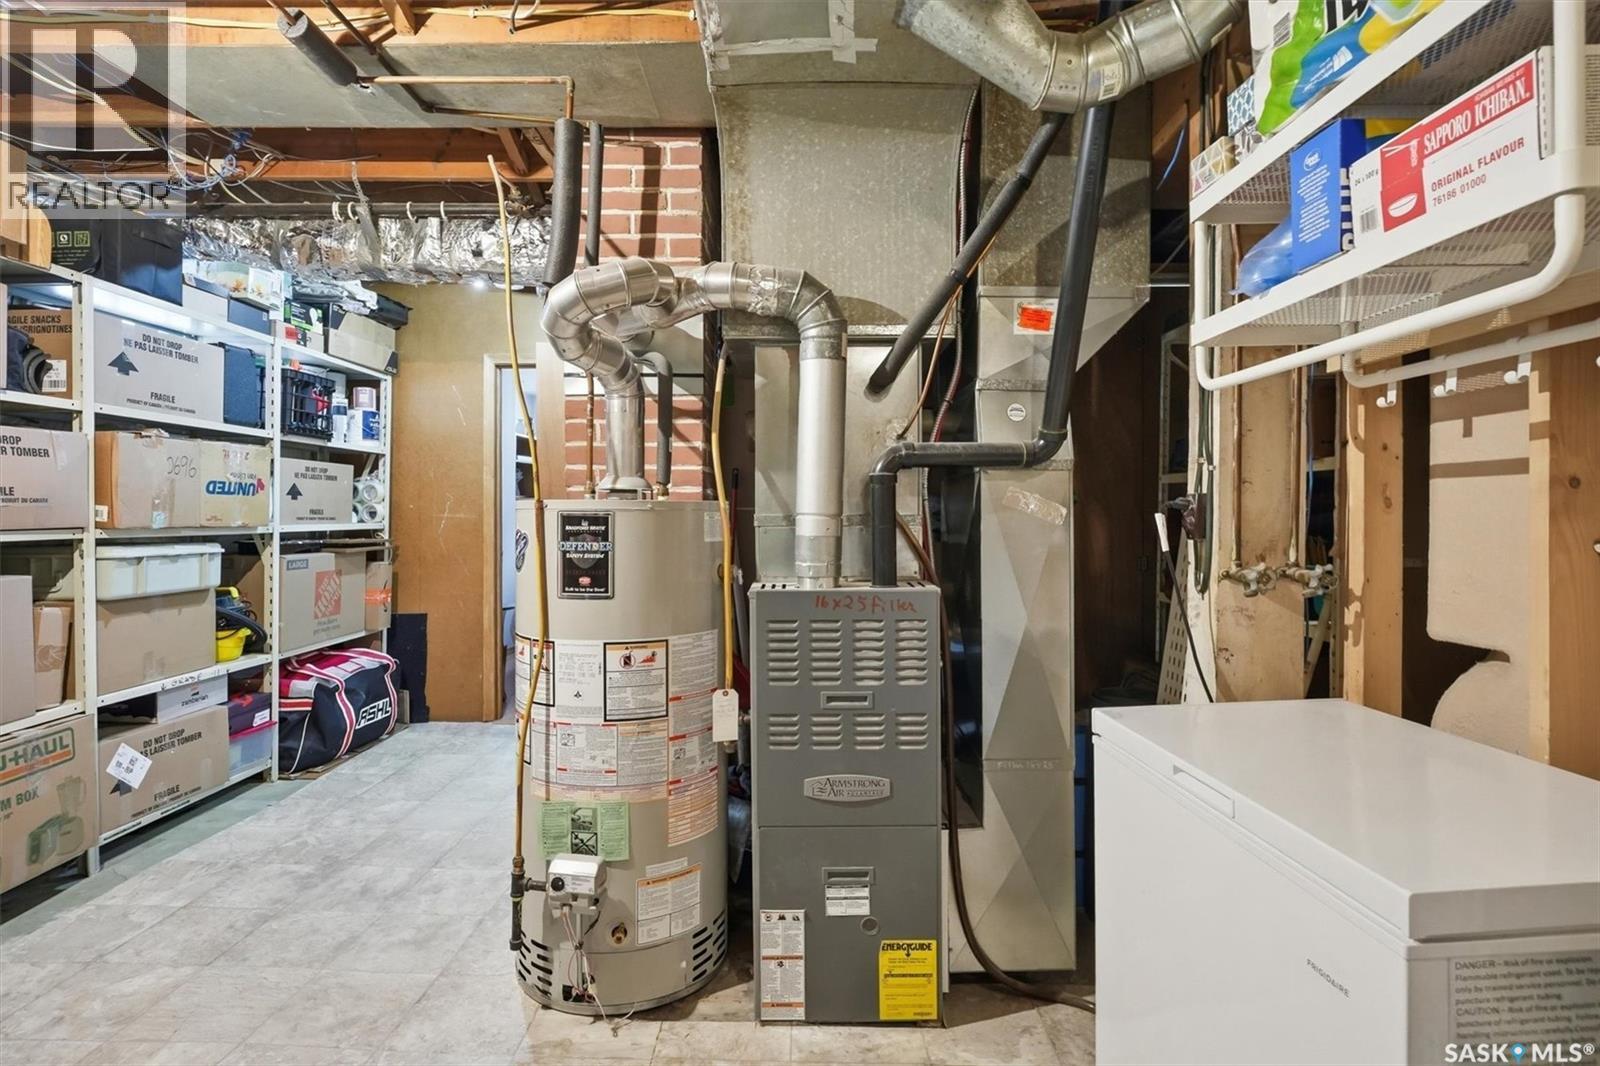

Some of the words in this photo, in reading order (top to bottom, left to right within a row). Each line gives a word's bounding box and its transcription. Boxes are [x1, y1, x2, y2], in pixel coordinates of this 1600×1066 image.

[1424, 110, 1472, 154] SAPPORO
[1431, 164, 1474, 192] ORIGINAL
[1478, 138, 1525, 169] FLAVOUR
[1460, 174, 1487, 194] 01000
[142, 334, 151, 343] DO
[153, 337, 165, 346] NOT
[166, 341, 183, 351] DROP
[134, 341, 147, 351] PAS
[175, 351, 199, 364] TOMBER
[150, 392, 176, 404] FRAGILE
[10, 447, 50, 458] TOMBER
[206, 480, 257, 497] UNITED
[560, 541, 613, 553] DEFENDER
[288, 559, 308, 569] LARGE
[143, 740, 152, 749] DO
[154, 735, 167, 745] NOT
[177, 731, 202, 747] TOMBER
[16, 787, 39, 806] BOX
[154, 784, 180, 801] FRAGILE
[1456, 960, 1496, 970] DANGER
[1307, 958, 1349, 998] FRIGIDAIRE
[1456, 1006, 1500, 1016] CAUTION
